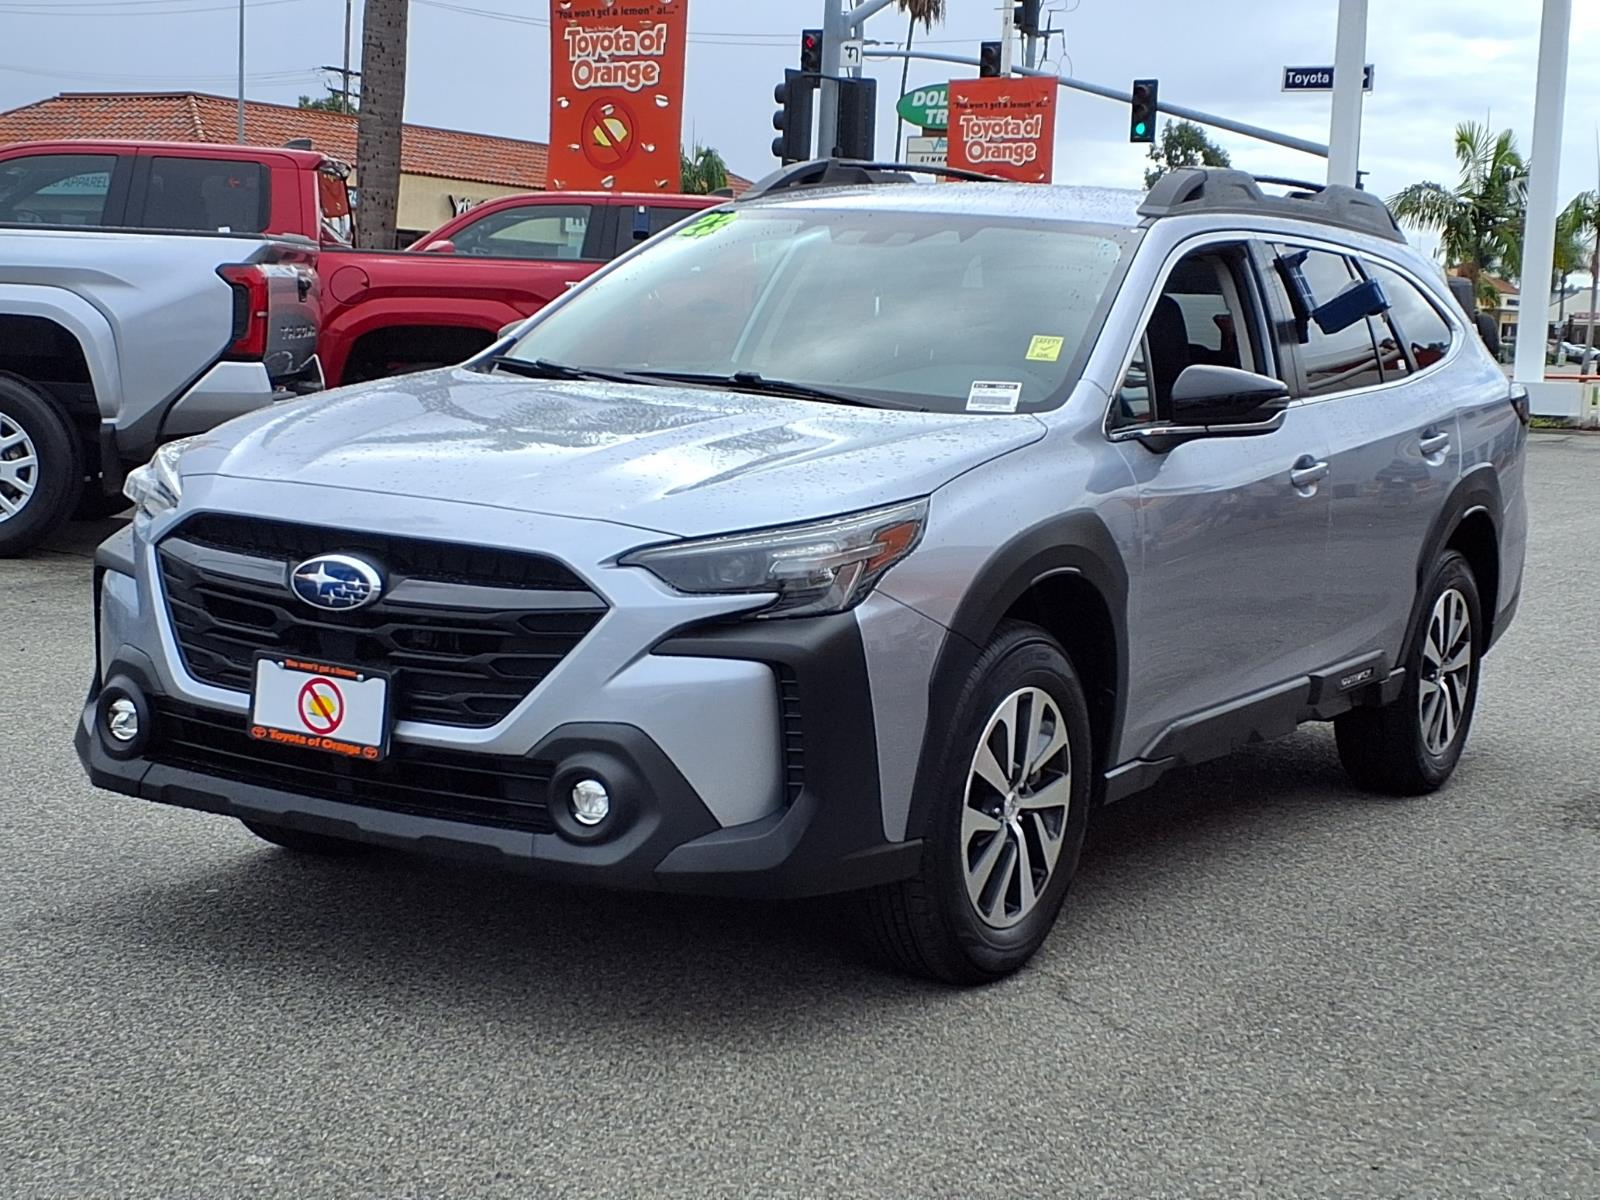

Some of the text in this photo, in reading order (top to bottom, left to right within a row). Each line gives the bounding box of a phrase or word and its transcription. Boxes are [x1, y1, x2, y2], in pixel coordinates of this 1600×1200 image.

[564, 24, 667, 60] Toyota of
[572, 59, 660, 92] Orange
[1287, 72, 1330, 86] Toyota
[960, 114, 1042, 141] Toyota of
[966, 140, 1036, 165] Orange
[269, 729, 361, 755] Toyota of Orange
